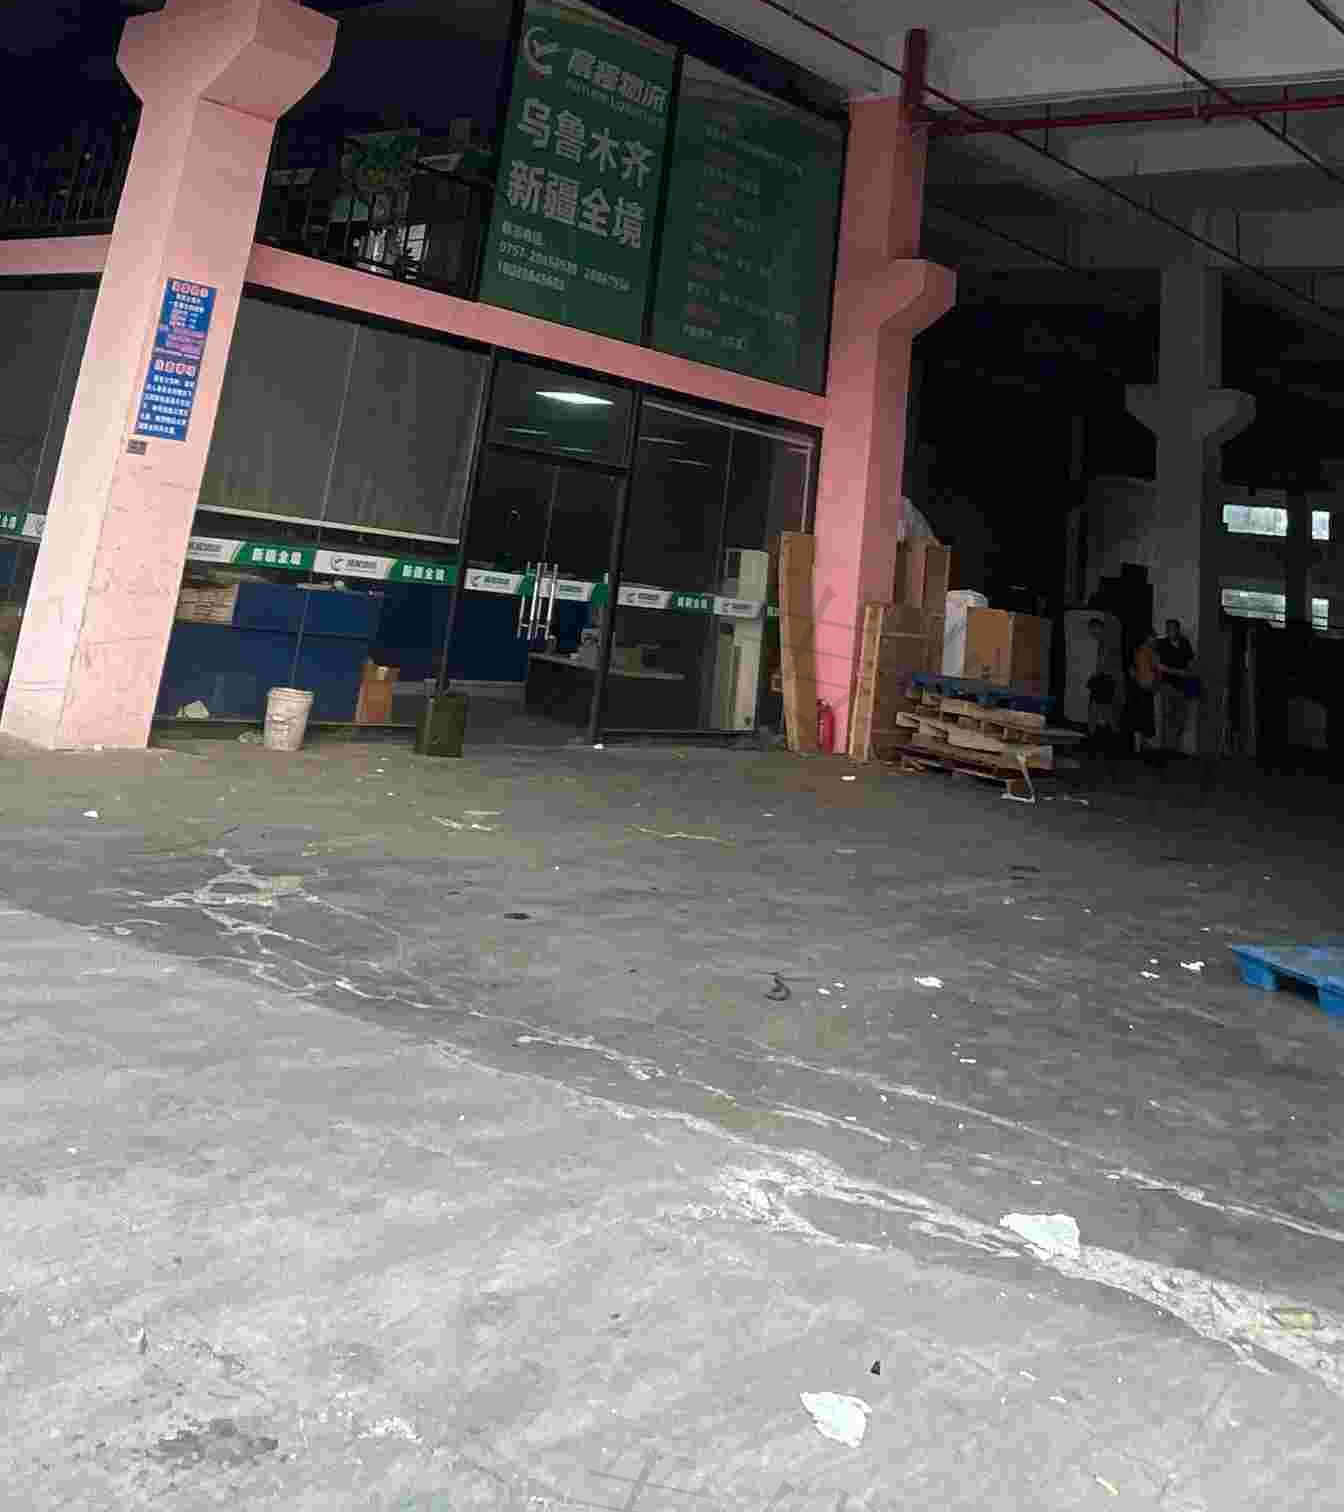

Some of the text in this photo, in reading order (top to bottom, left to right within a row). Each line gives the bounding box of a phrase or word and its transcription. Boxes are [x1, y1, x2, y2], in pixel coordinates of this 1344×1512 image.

[519, 97, 654, 187] 乌鲁木齐
[506, 159, 646, 249] 新疆全境
